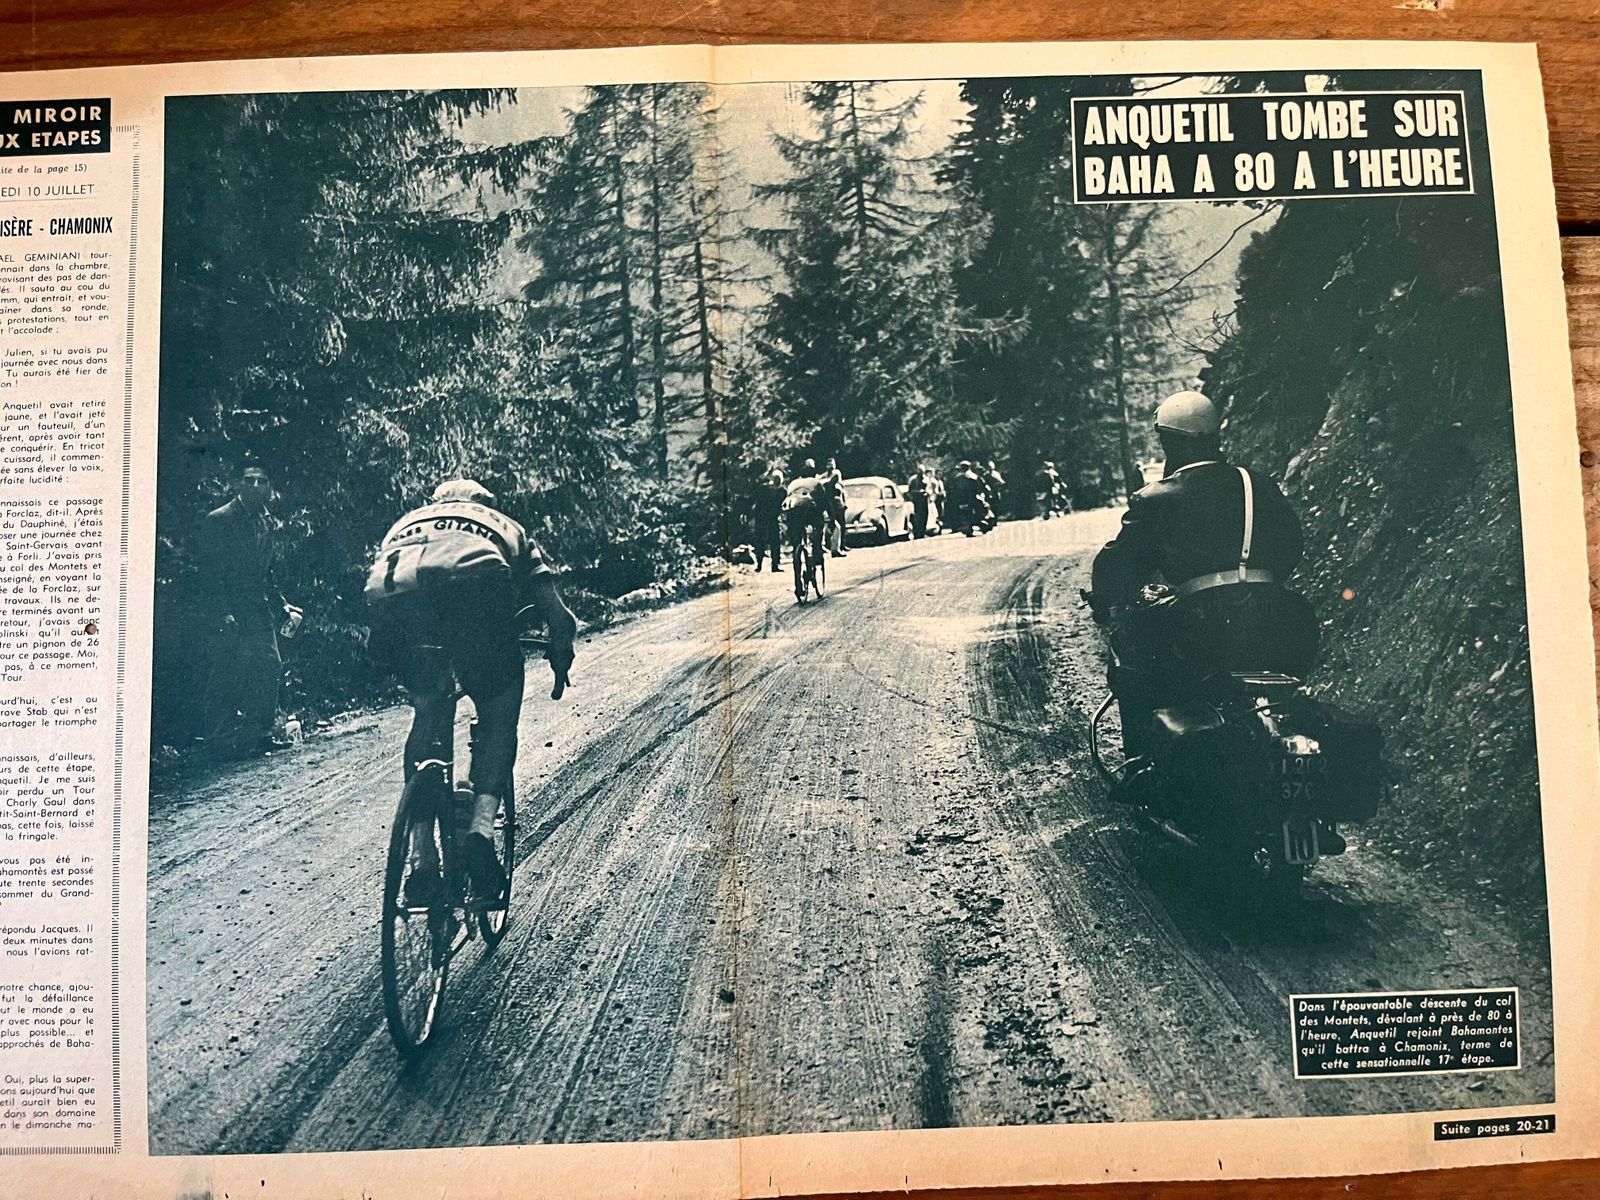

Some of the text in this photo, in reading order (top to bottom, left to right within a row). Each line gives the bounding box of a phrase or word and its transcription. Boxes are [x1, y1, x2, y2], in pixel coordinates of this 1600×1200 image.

[13, 106, 102, 125] MIROIR
[1083, 99, 1459, 150] ANQUETIL TOMBE SUR
[31, 129, 102, 148] ETAPES
[17, 166, 29, 174] de
[33, 166, 42, 174] la
[47, 164, 69, 174] page
[74, 164, 87, 172] 15)
[1083, 148, 1464, 196] BAHA A 80 A L'HEURE
[28, 186, 41, 197] 10
[45, 184, 95, 196] JUILLET
[49, 217, 113, 236] CHAMONIX
[24, 252, 81, 262] GEMINIANI
[29, 262, 110, 272] dans la chambre,
[7, 315, 67, 325] protestations,
[5, 348, 34, 357] Julien,
[67, 347, 91, 355] avais
[96, 346, 108, 354] pu
[1, 358, 34, 369] journée
[86, 356, 108, 364] dans
[2, 400, 106, 411] Anquetil avait retiré
[4, 410, 105, 422] jaune, et l'avait jeté
[10, 442, 104, 454] conquérir. En tricot
[4, 455, 44, 463] cuissard,
[61, 453, 104, 461] commen-
[66, 498, 104, 506] passage
[6, 507, 103, 518] Forclaz, dit-il. Après
[3, 519, 103, 529] du Dauphiné, j'étais
[6, 541, 68, 551] Saint-Gervais
[10, 563, 24, 571] col
[28, 563, 44, 571] des
[48, 562, 88, 570] Montets
[11, 606, 52, 615] terminés
[88, 606, 100, 614] un
[16, 638, 100, 649] un pignon de 26
[4, 664, 23, 672] pas,
[28, 662, 35, 670] à
[57, 661, 98, 670] moment,
[18, 763, 95, 773] de cette étape,
[17, 787, 44, 797] perdu
[72, 785, 95, 794] Tour
[6, 797, 95, 808] Charly Gaul dans
[5, 832, 58, 842] la fringale.
[52, 877, 94, 886] secondes
[41, 924, 81, 935] Jacques.
[3, 937, 26, 945] deux
[71, 936, 93, 944] dans
[34, 947, 70, 955] l'avions
[28, 983, 64, 992] chance,
[68, 984, 94, 992] ajou-
[2, 993, 94, 1003] fut la défaillance
[1299, 995, 1512, 1012] Dans l'épouvantable descente du col
[1300, 1009, 1512, 1026] des Montets, dévalant à près de 80 à
[1, 1028, 20, 1037] plus
[29, 1028, 76, 1037] possible...
[1300, 1024, 1513, 1042] l'heure, Anquetil rejoint Bahamontes
[1301, 1037, 1513, 1057] qu'il battra à Chamonix, terme de
[1321, 1058, 1349, 1070] cette
[1356, 1055, 1431, 1068] sensationnelle
[1461, 1053, 1494, 1065] étape.
[4, 1074, 95, 1085] Oui, plus la super-
[4, 1109, 27, 1118] dans
[55, 1109, 96, 1117] domaine
[1441, 1119, 1550, 1136] Suite pages 20-21
